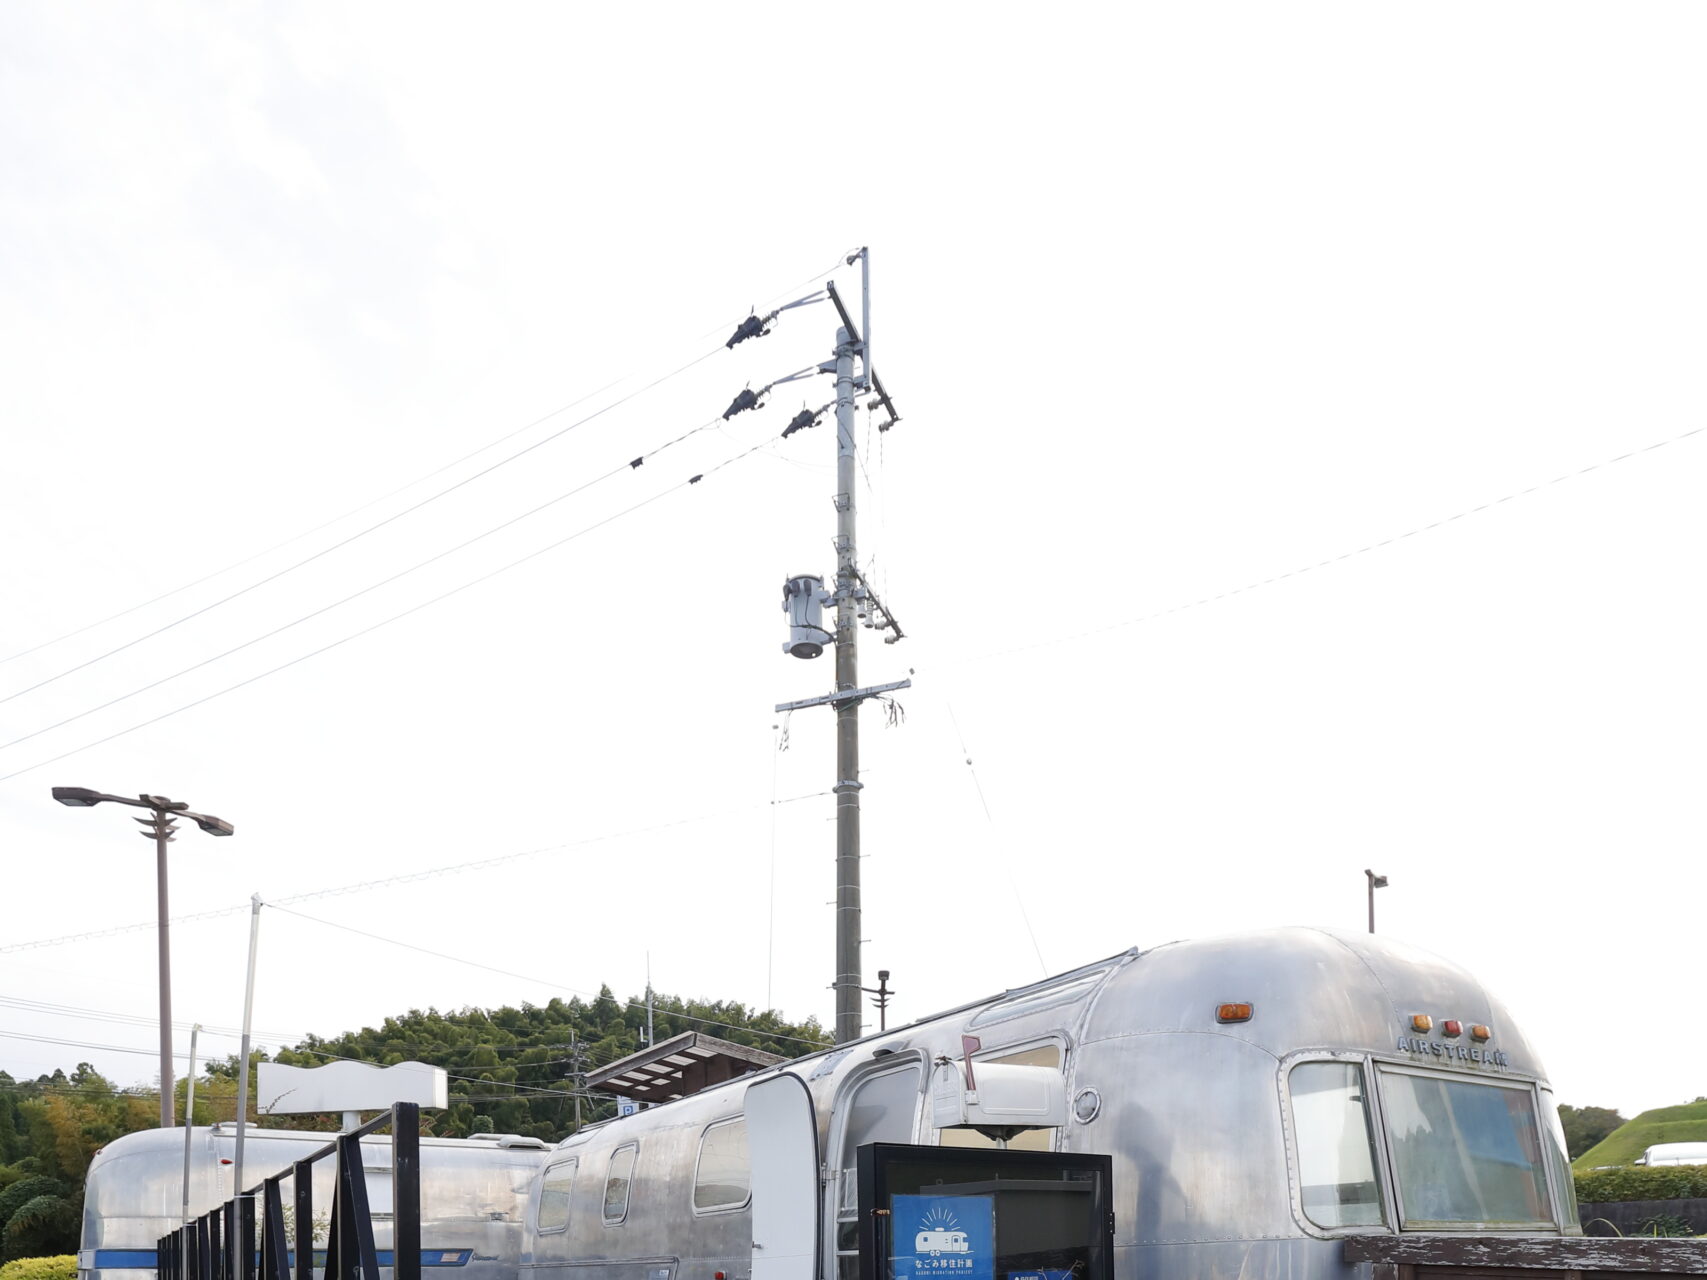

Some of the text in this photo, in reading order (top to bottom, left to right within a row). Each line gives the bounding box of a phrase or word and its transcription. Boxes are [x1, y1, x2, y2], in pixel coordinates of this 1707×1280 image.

[1398, 1037, 1508, 1066] AIRSTREAM
[915, 1259, 973, 1268] なごみ移住計画
